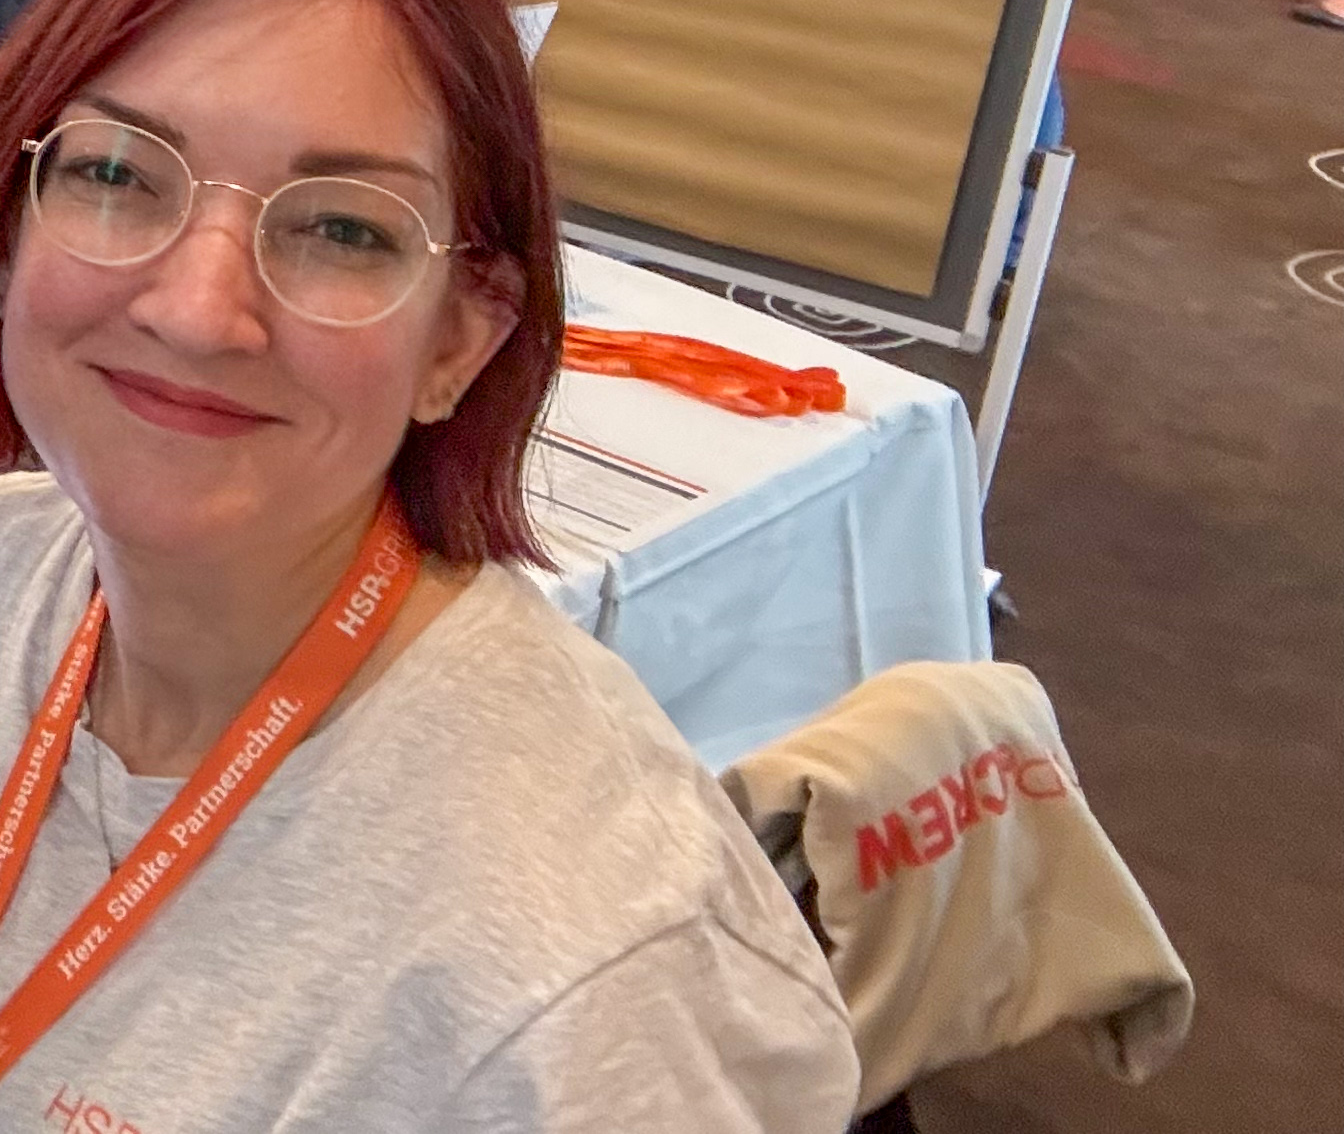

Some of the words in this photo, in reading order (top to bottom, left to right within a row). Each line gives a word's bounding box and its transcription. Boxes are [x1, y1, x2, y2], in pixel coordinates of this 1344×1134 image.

[57, 923, 113, 981] Herz.
[106, 849, 178, 922] Stärke.
[168, 695, 305, 849] Partnerschaft.
